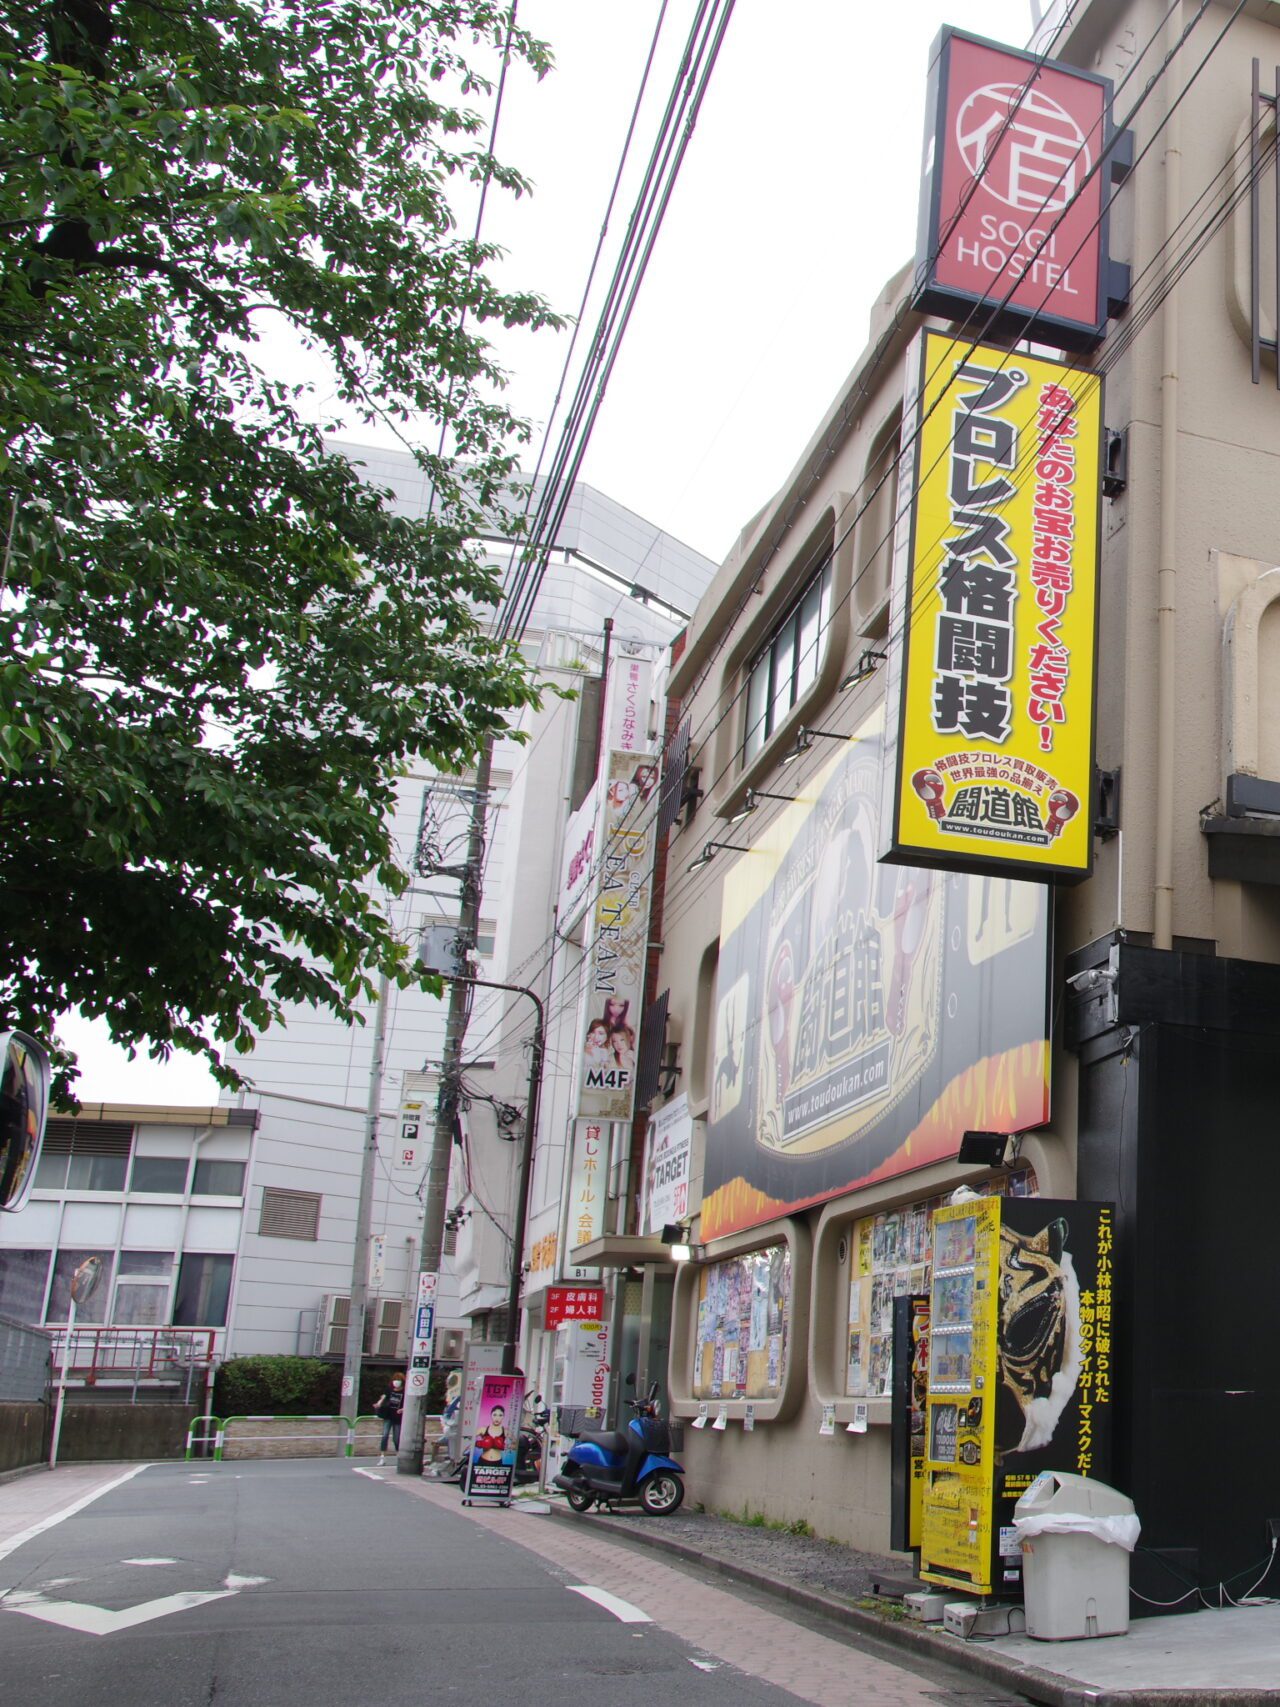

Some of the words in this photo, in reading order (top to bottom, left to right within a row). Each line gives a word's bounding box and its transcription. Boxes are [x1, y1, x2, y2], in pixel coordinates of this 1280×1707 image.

[980, 214, 1056, 258] SOGI
[957, 237, 1079, 294] HOSTEL
[932, 361, 1029, 742] プロレス格闘技
[934, 752, 1060, 791] 格闘技プロレス買取販売
[950, 767, 1043, 797] 世界最強の品揃え
[948, 786, 1045, 831] 闘道館
[945, 823, 1046, 843] www.toudoukan.com
[586, 1068, 629, 1089] M4F
[787, 1059, 885, 1125] www.toudoukan.com
[404, 1125, 417, 1137] P
[577, 1125, 601, 1244] 貸しホール・会議
[655, 1150, 689, 1189] TARGET
[575, 1269, 587, 1278] B1
[565, 1305, 597, 1315] 婦人科
[566, 1292, 598, 1302] 皮膚科
[1095, 1209, 1113, 1403] これが小林邦昭に破られた
[1077, 1289, 1095, 1478] 本物のタイガーマスクだ！
